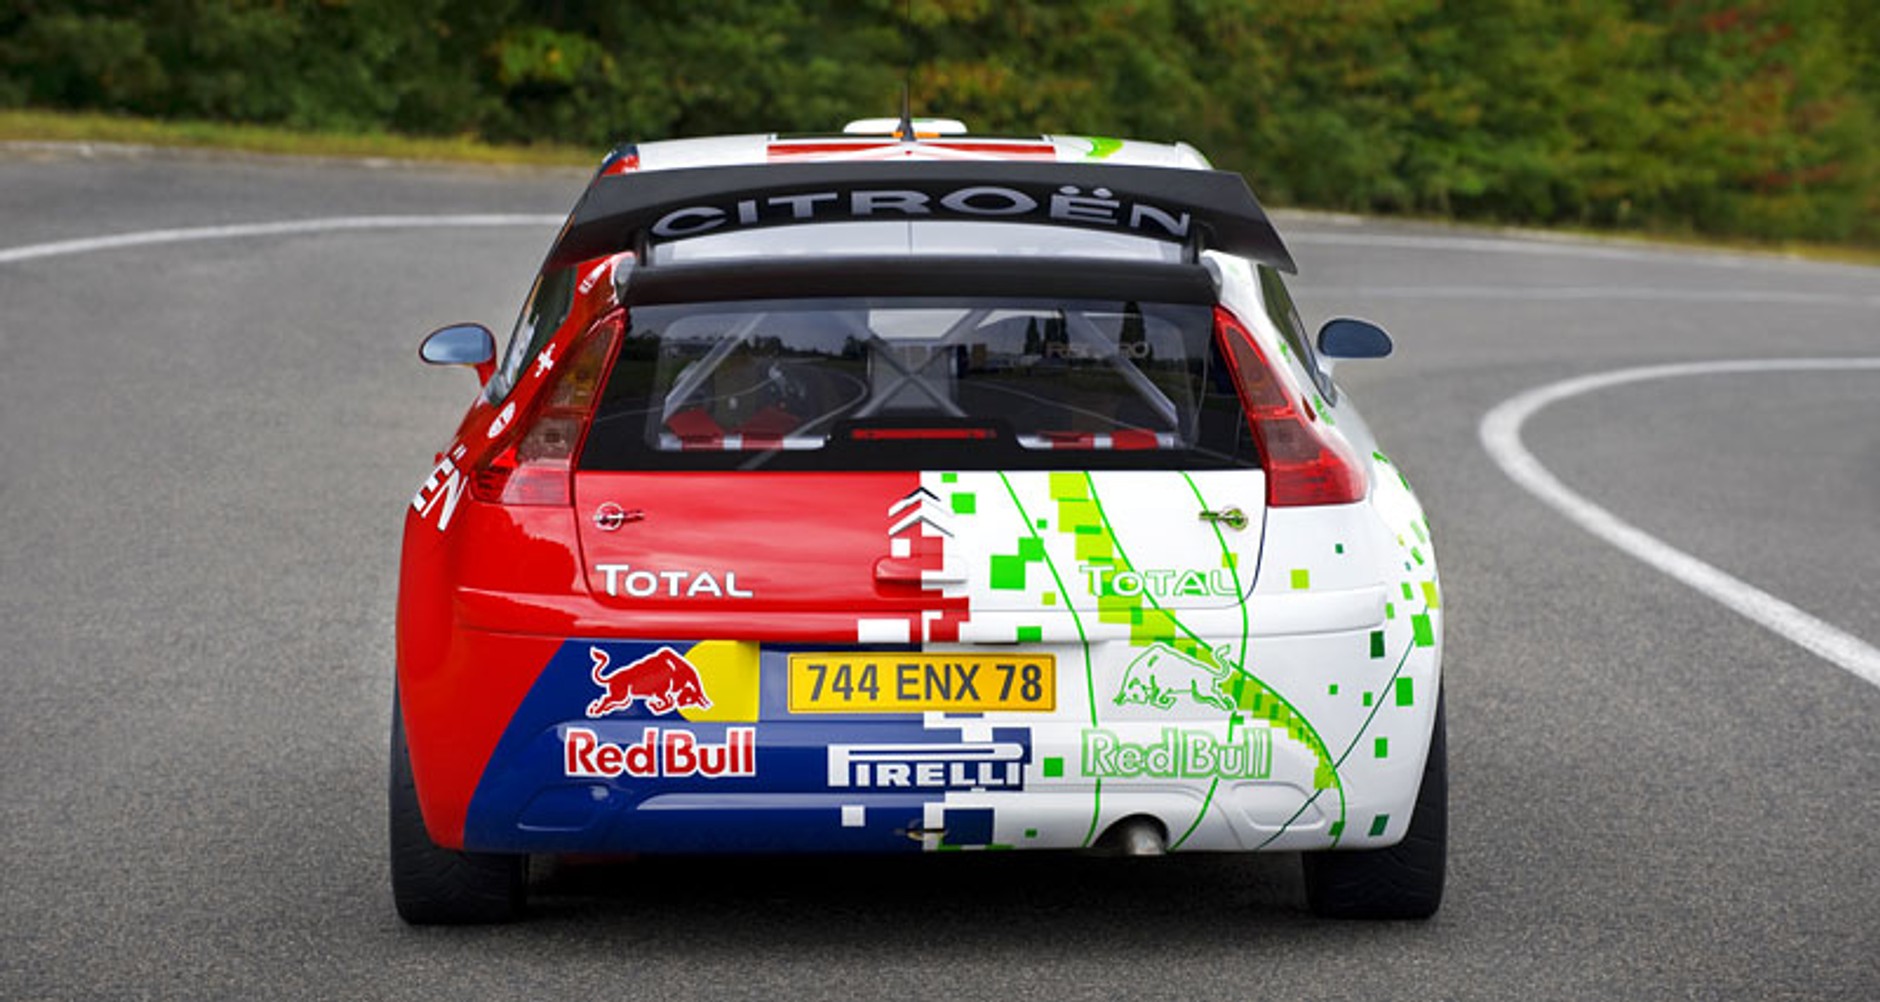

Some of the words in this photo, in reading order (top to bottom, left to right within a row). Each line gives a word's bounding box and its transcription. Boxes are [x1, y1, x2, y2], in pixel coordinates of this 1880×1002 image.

[650, 186, 1190, 238] CITROËN
[595, 564, 754, 598] TOTAL
[1079, 565, 1240, 597] TOTAL
[807, 663, 880, 701] 744
[896, 663, 981, 701] ENX
[996, 663, 1043, 701] 78
[566, 727, 659, 777] Red
[663, 727, 756, 777] Bull
[828, 744, 1024, 787] PIRELLI
[1081, 727, 1179, 778] Red
[1181, 727, 1272, 779] Bull
